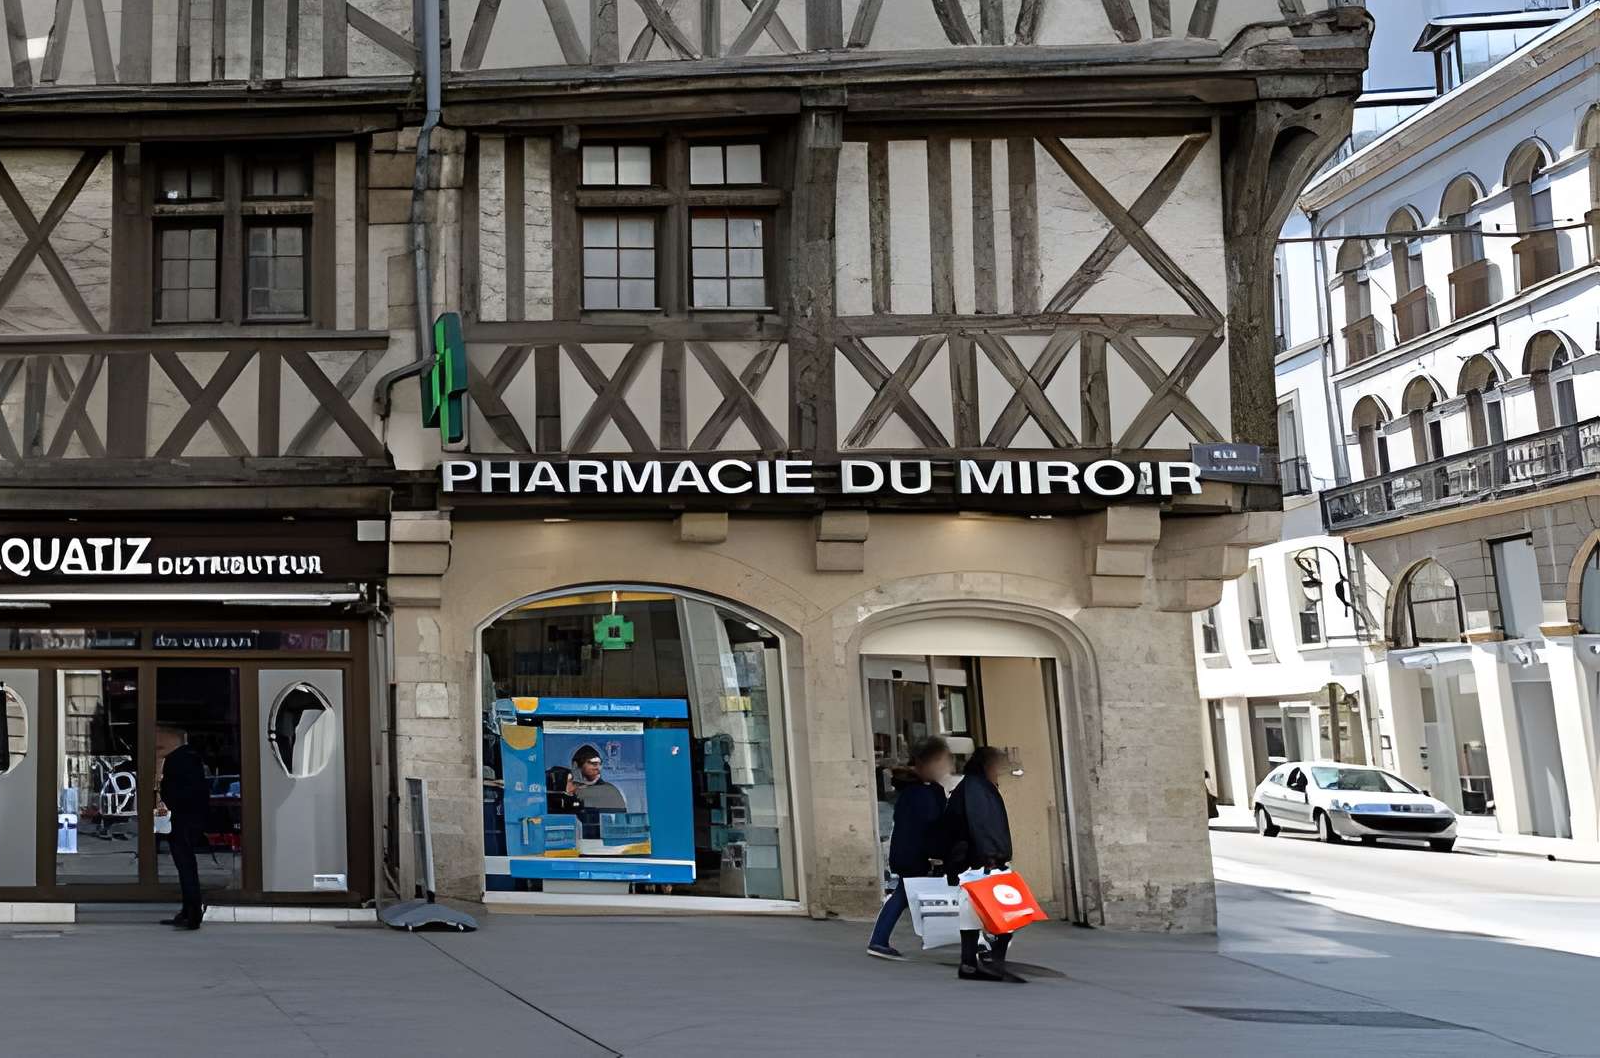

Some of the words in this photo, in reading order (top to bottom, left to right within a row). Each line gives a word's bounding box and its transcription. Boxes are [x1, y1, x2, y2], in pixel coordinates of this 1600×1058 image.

[443, 460, 814, 493] PHARMACIE
[841, 460, 932, 494] DU
[960, 459, 1202, 495] MIROIR
[158, 555, 323, 575] DISTRIBUTEUR
